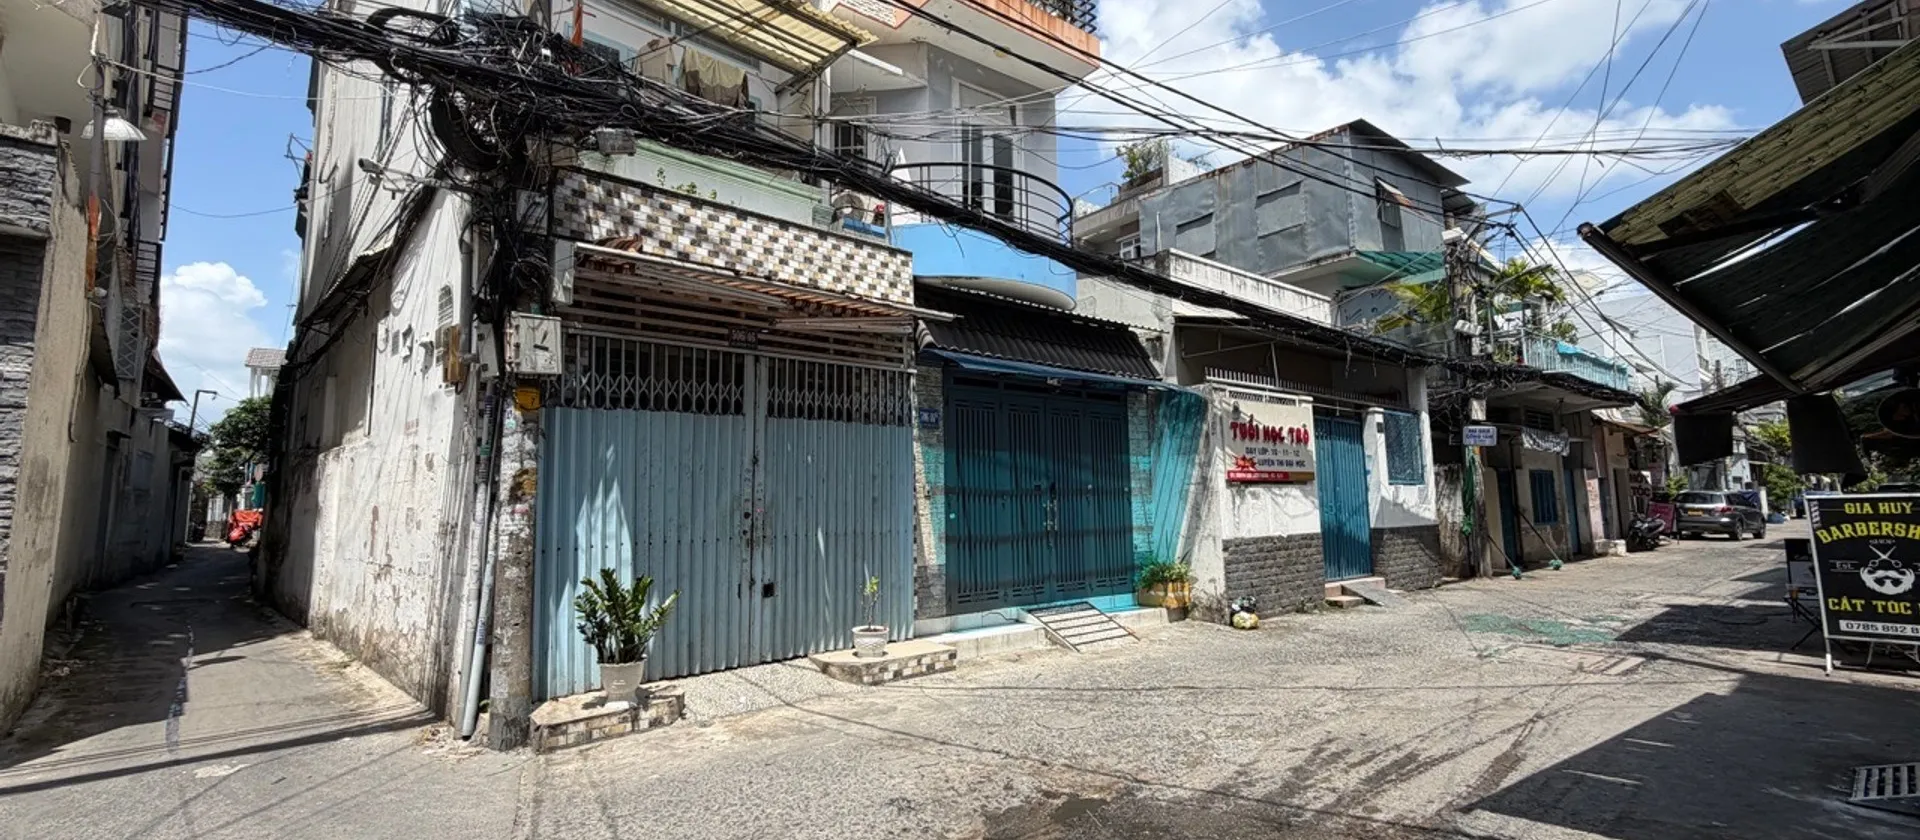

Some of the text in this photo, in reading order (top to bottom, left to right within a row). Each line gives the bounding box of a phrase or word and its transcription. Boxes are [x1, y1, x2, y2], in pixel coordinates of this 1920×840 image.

[1230, 414, 1310, 446] TUỔI HỌC TRÒ
[1844, 502, 1913, 514] GIA HUY
[1845, 622, 1879, 632] 0785
[1881, 624, 1908, 635] 892
